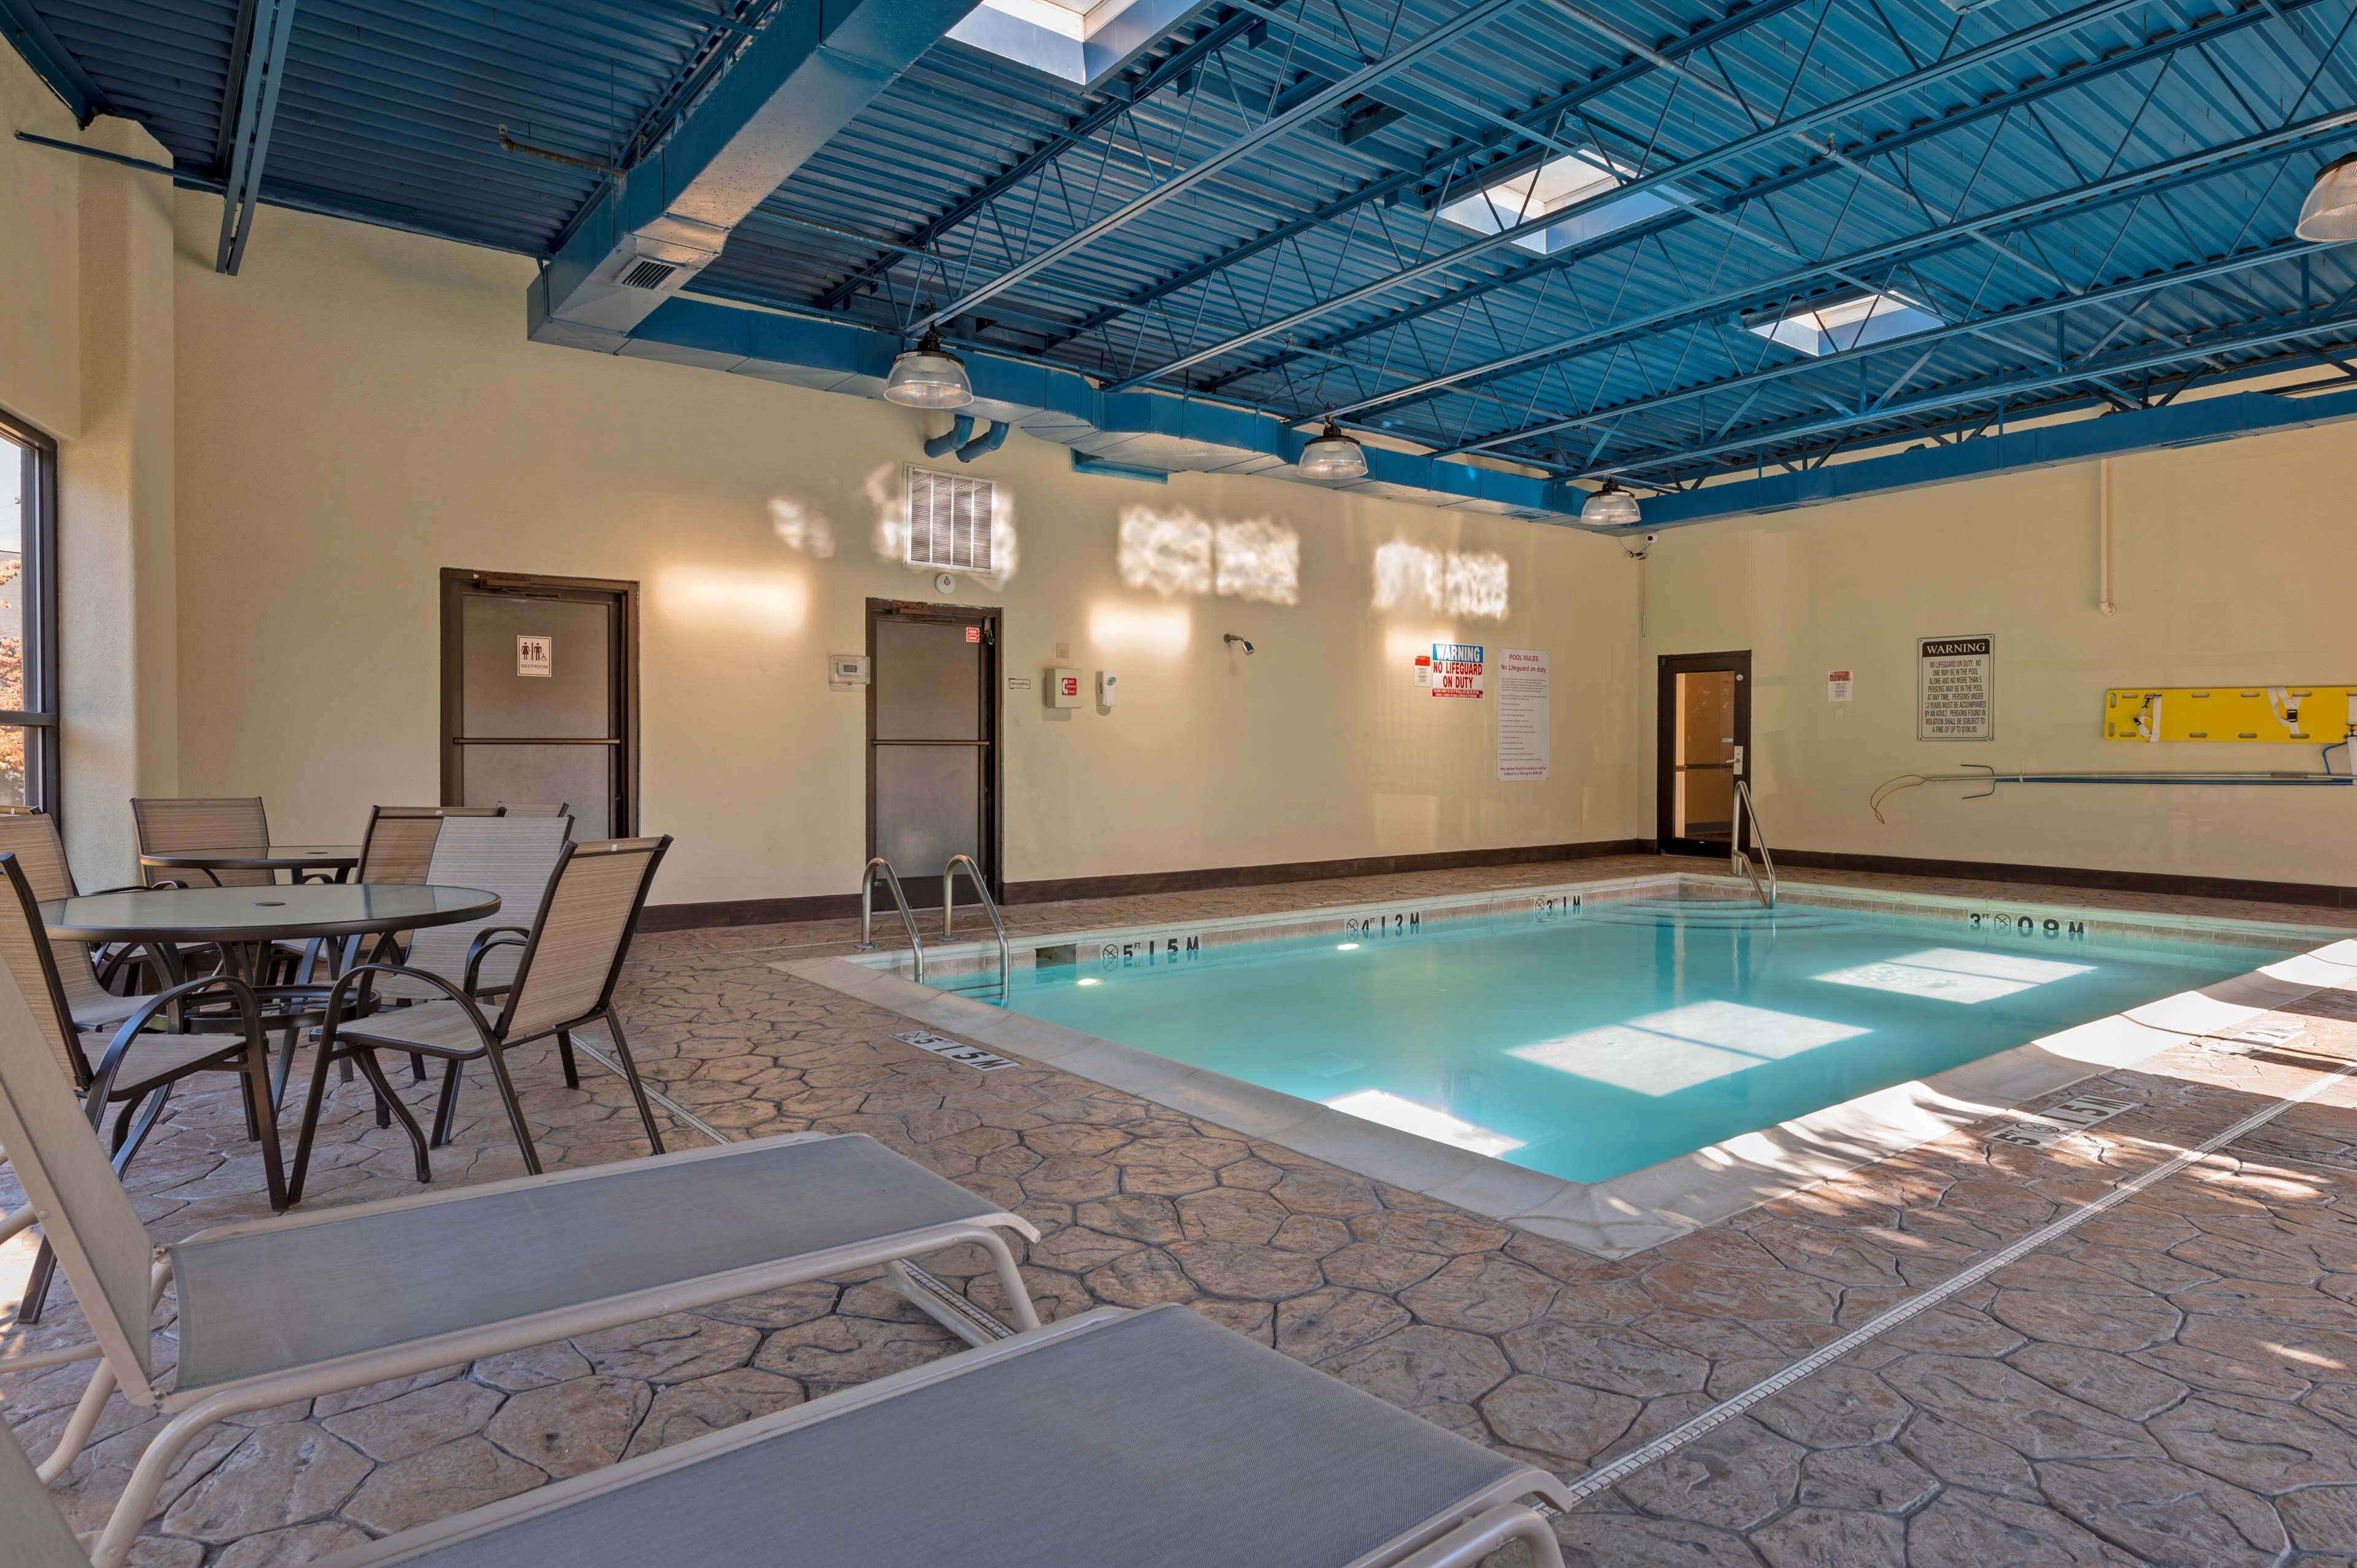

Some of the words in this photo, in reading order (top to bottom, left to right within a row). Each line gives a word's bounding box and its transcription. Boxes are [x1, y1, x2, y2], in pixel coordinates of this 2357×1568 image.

[1436, 645, 1480, 662] WARNING
[1927, 643, 1986, 654] WARNING
[1433, 661, 1443, 673] NO
[1446, 662, 1482, 675] LIFEGUARD
[1443, 677, 1452, 688] ON
[1455, 677, 1474, 689] DUTY
